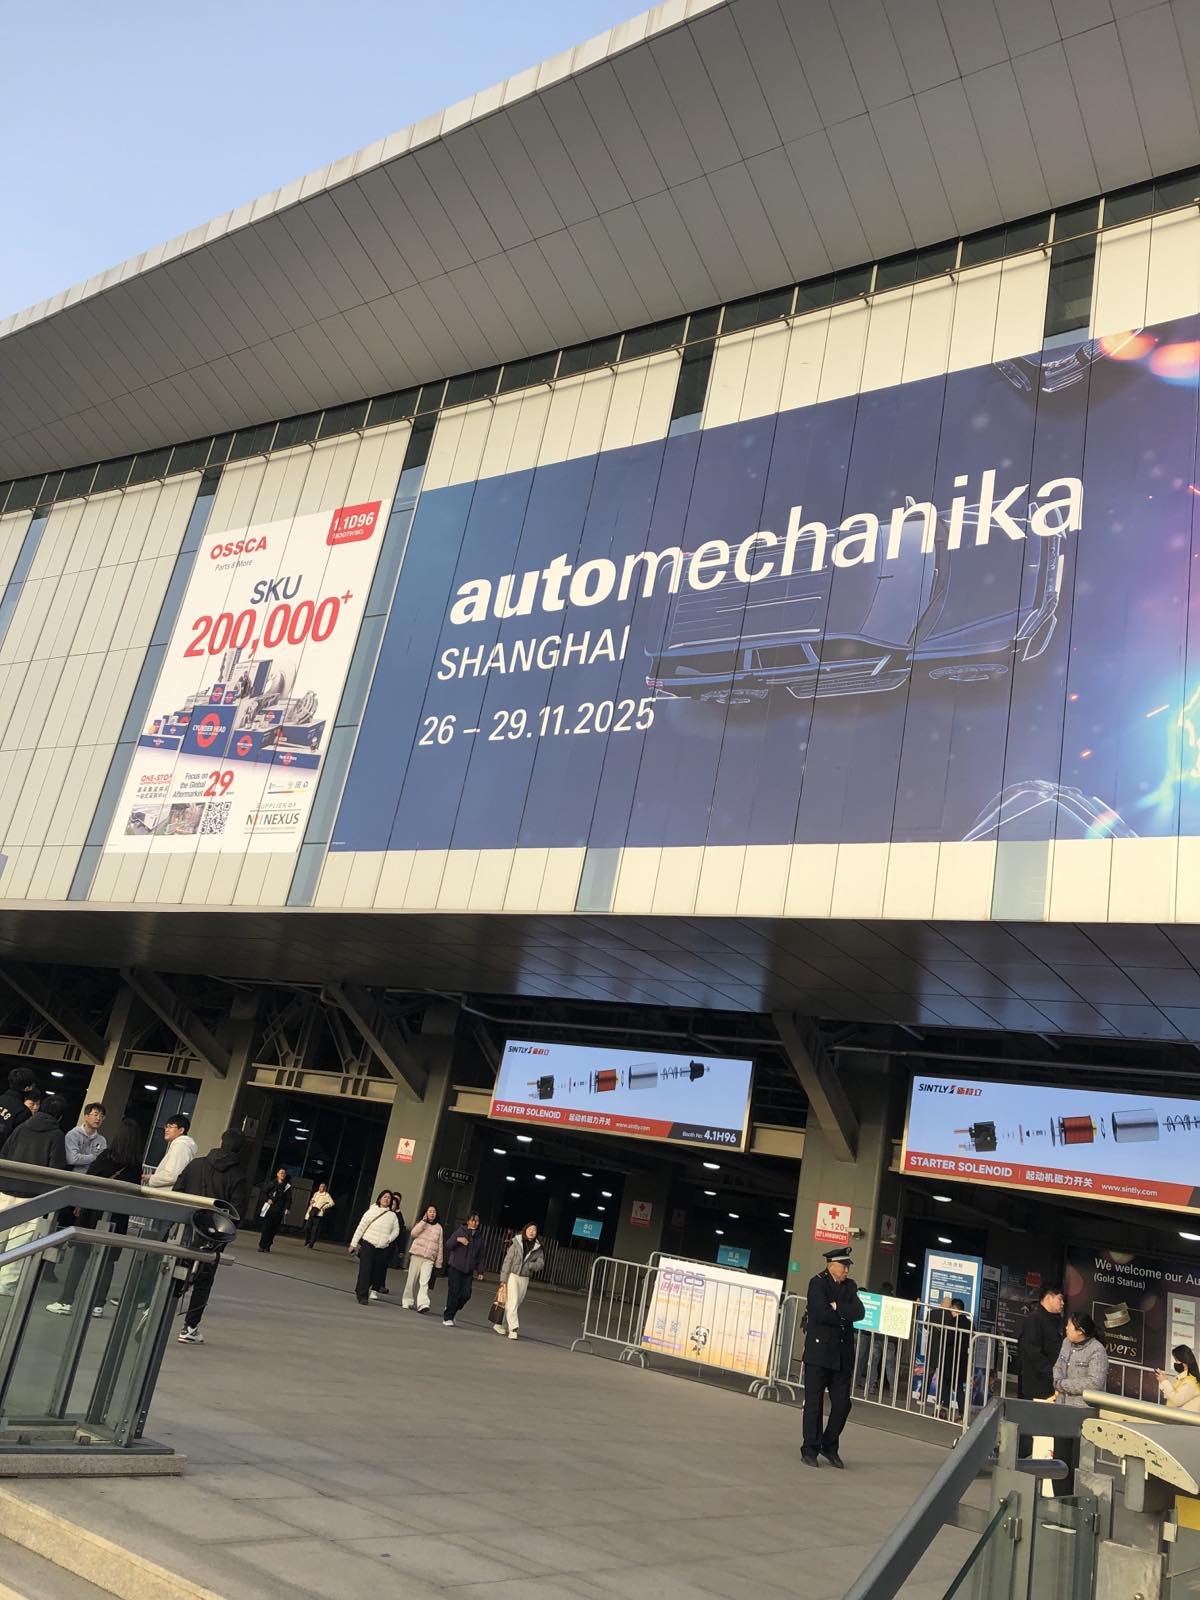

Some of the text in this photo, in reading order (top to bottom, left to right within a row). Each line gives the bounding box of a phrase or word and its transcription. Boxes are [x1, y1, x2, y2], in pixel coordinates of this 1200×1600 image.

[333, 512, 374, 531] 1.1D96
[210, 536, 267, 560] OSSCA
[449, 469, 1083, 625] automechanika
[250, 575, 302, 605] SKU
[437, 625, 630, 680] SHANGHAI
[418, 714, 456, 746] 26
[488, 697, 656, 741] 29.11.2025
[204, 770, 234, 796] 29
[264, 813, 300, 825] NEXUS
[508, 1046, 528, 1054] SINTLY
[918, 1084, 950, 1094] SINTLY
[496, 1104, 561, 1119] STARTER SOLENOID
[704, 1130, 737, 1143] 4.1H96
[910, 1156, 1012, 1178] STARTER SOLENOID
[1025, 1170, 1094, 1188] 起动机磁力开关
[1101, 1184, 1158, 1197] www.sintly.com
[1094, 1257, 1112, 1271] We
[1114, 1264, 1162, 1280] welcome
[1164, 1272, 1183, 1282] our
[1094, 1272, 1146, 1291] (Gold Status)
